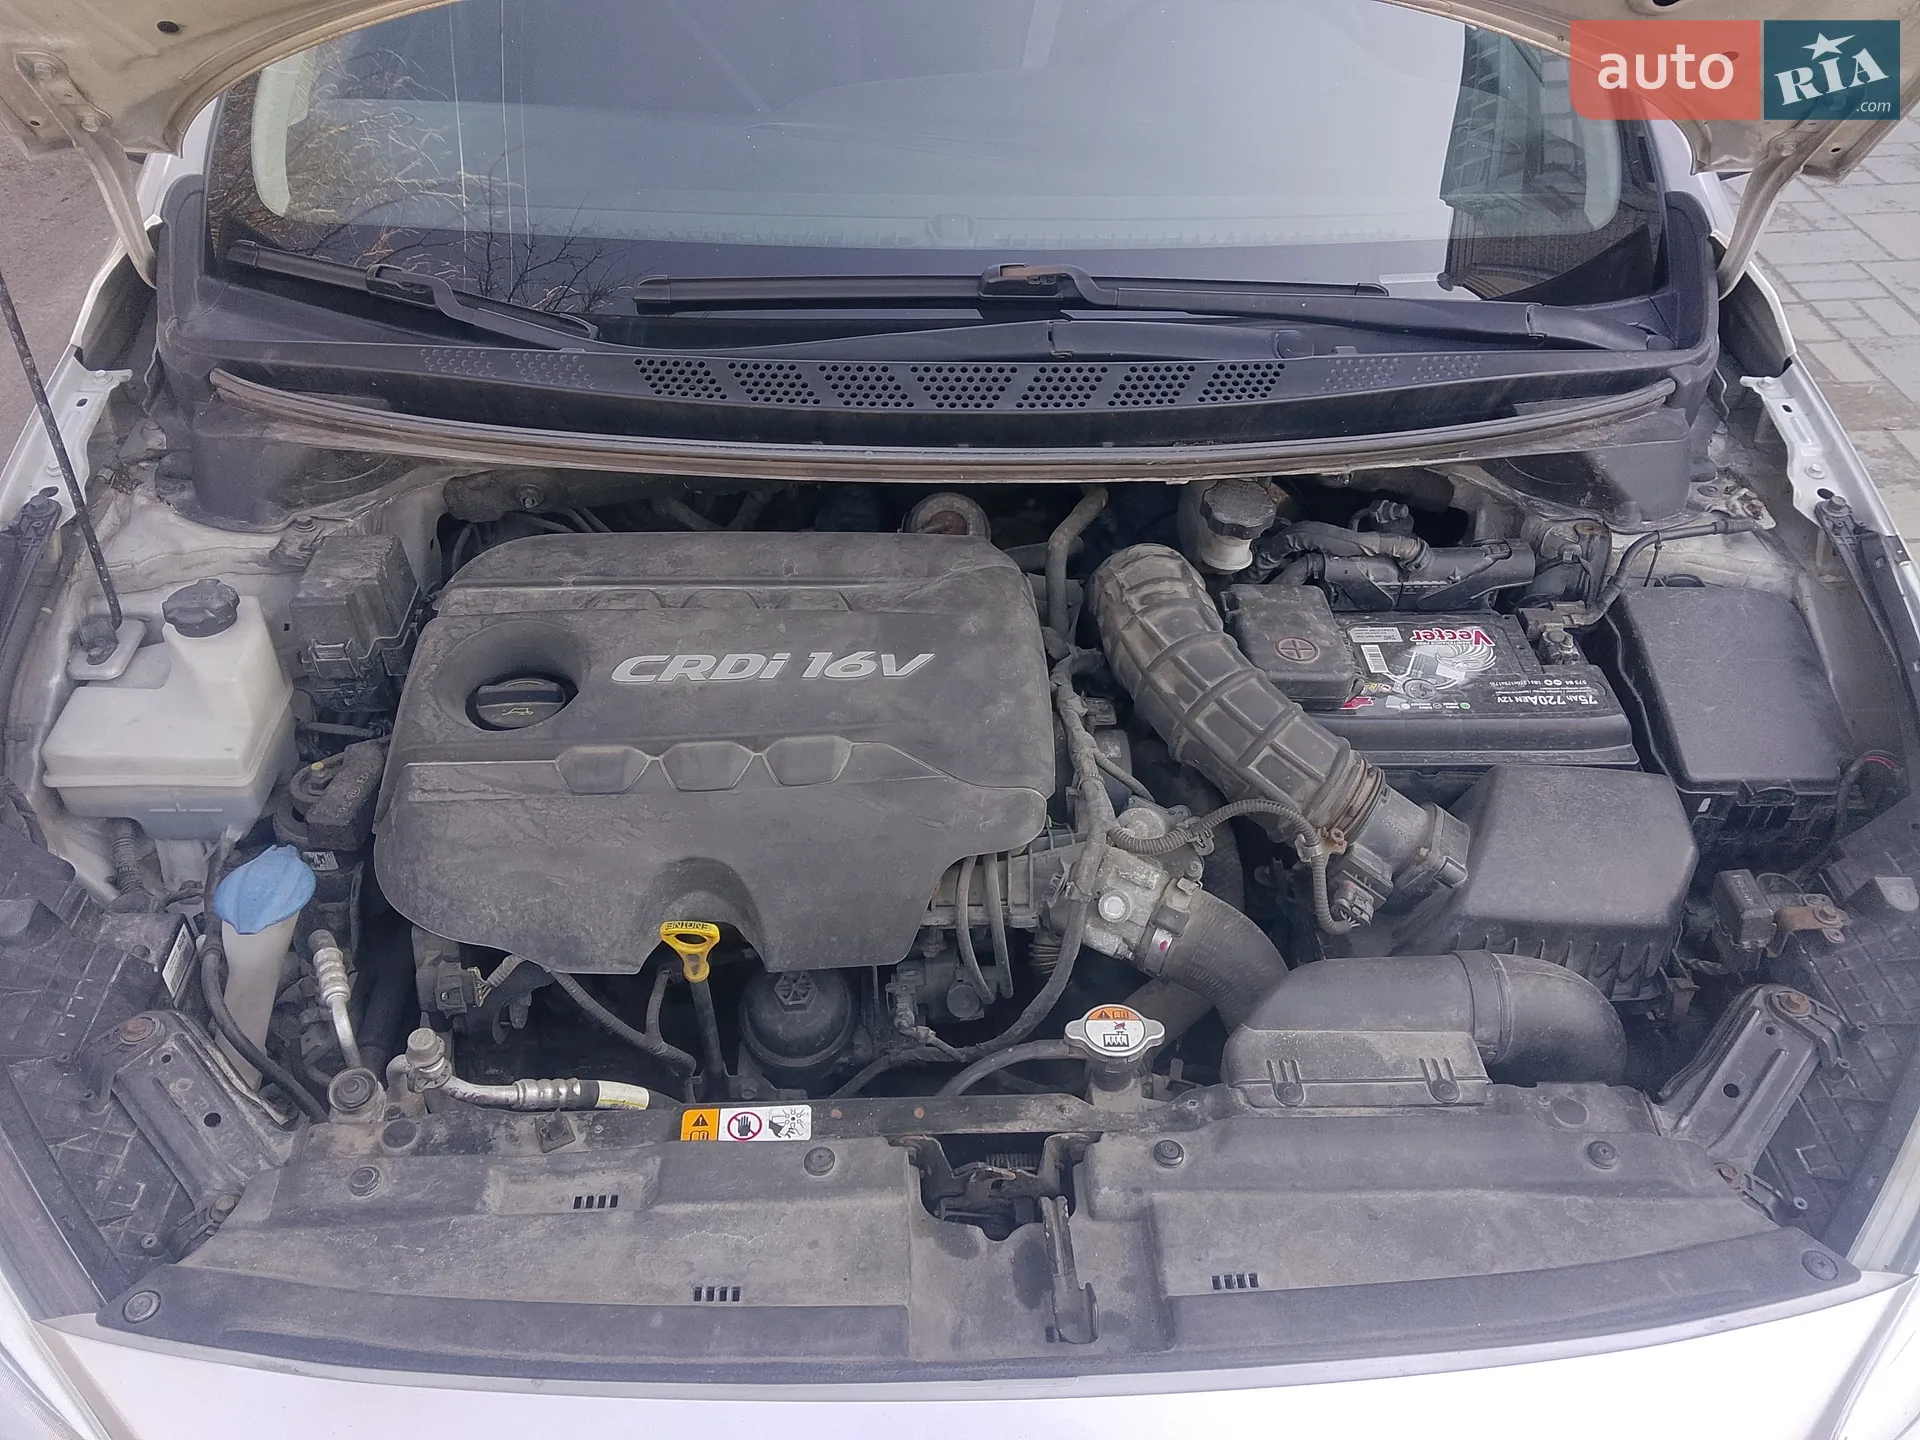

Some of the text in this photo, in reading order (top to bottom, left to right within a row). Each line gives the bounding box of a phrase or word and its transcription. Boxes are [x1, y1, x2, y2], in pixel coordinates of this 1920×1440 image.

[1410, 627, 1496, 647] Vecter
[611, 651, 936, 683] CRDi 16V
[1566, 695, 1598, 705] 75Ah
[665, 921, 710, 930] ENGINE
